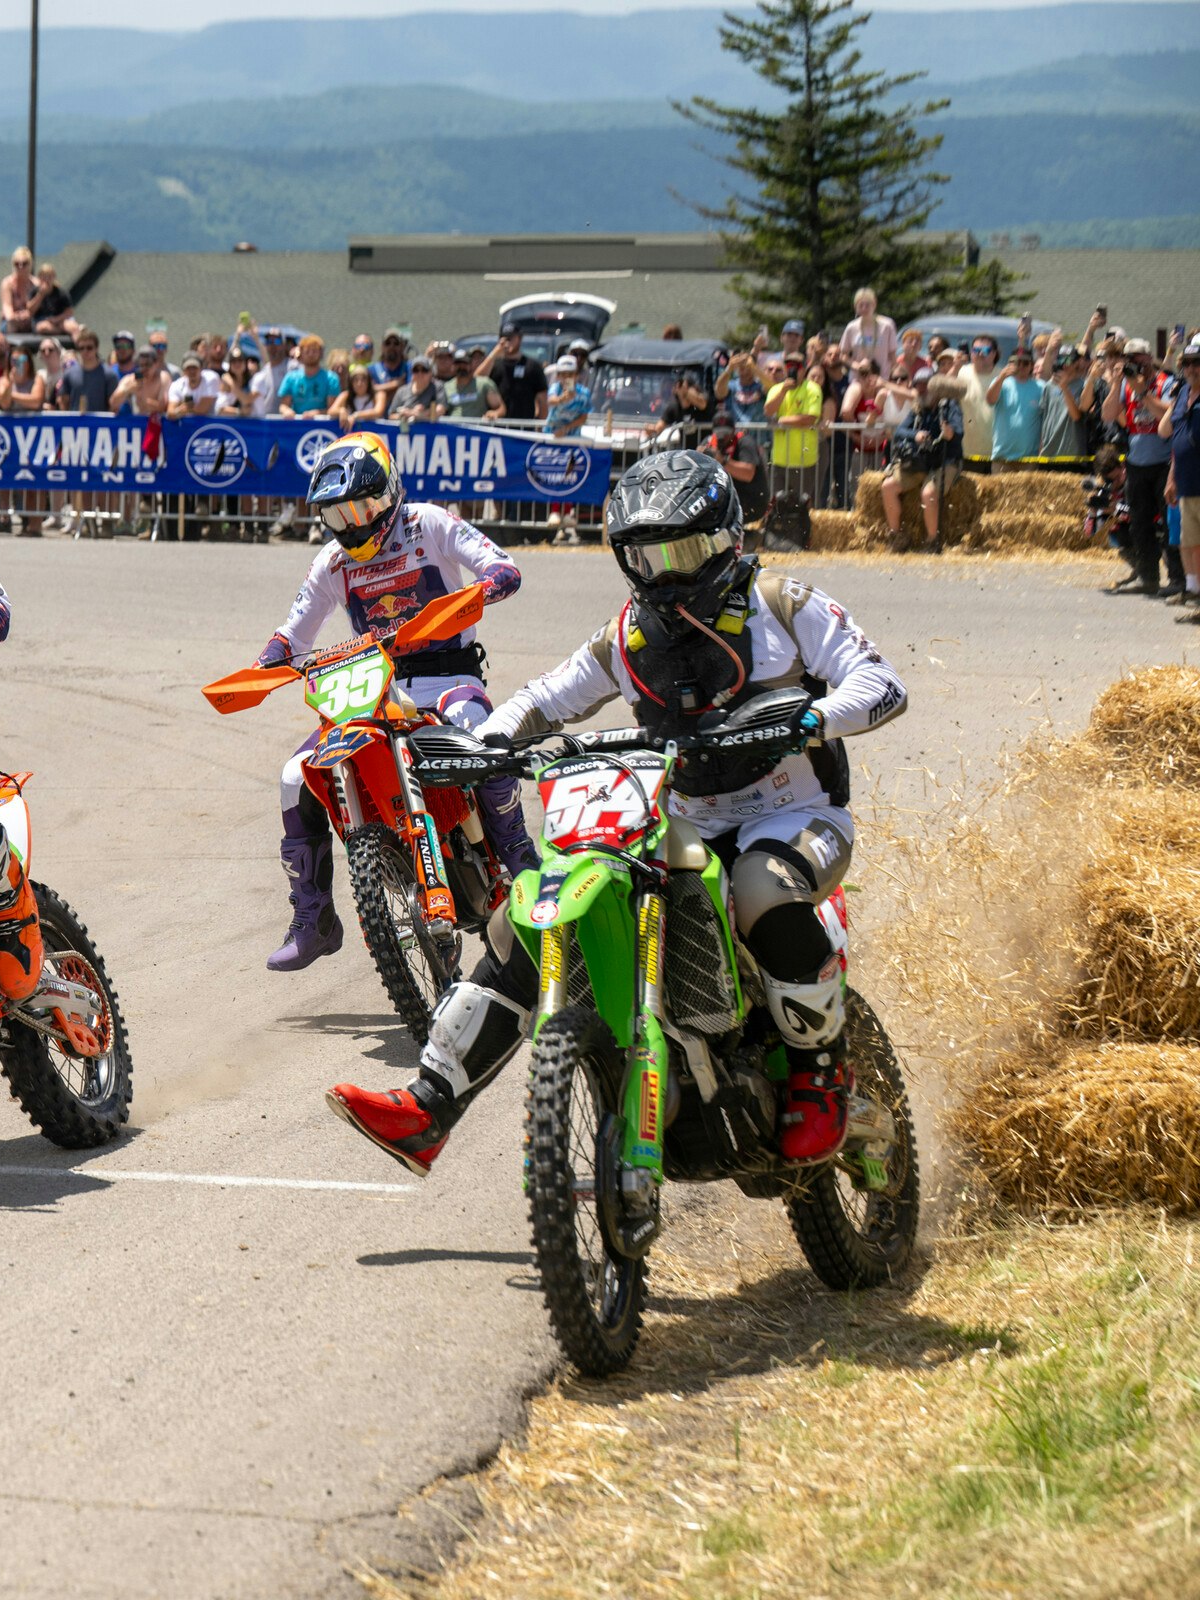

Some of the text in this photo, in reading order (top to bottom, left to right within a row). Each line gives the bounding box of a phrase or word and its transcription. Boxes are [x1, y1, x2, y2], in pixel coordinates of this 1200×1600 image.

[349, 552, 409, 581] MOOSE
[320, 648, 380, 675] GNCCRACING.COM
[317, 655, 384, 719] 35
[719, 725, 792, 747] ACERBIS
[415, 817, 435, 875] DUNLP
[639, 1071, 660, 1142] PIRELLI
